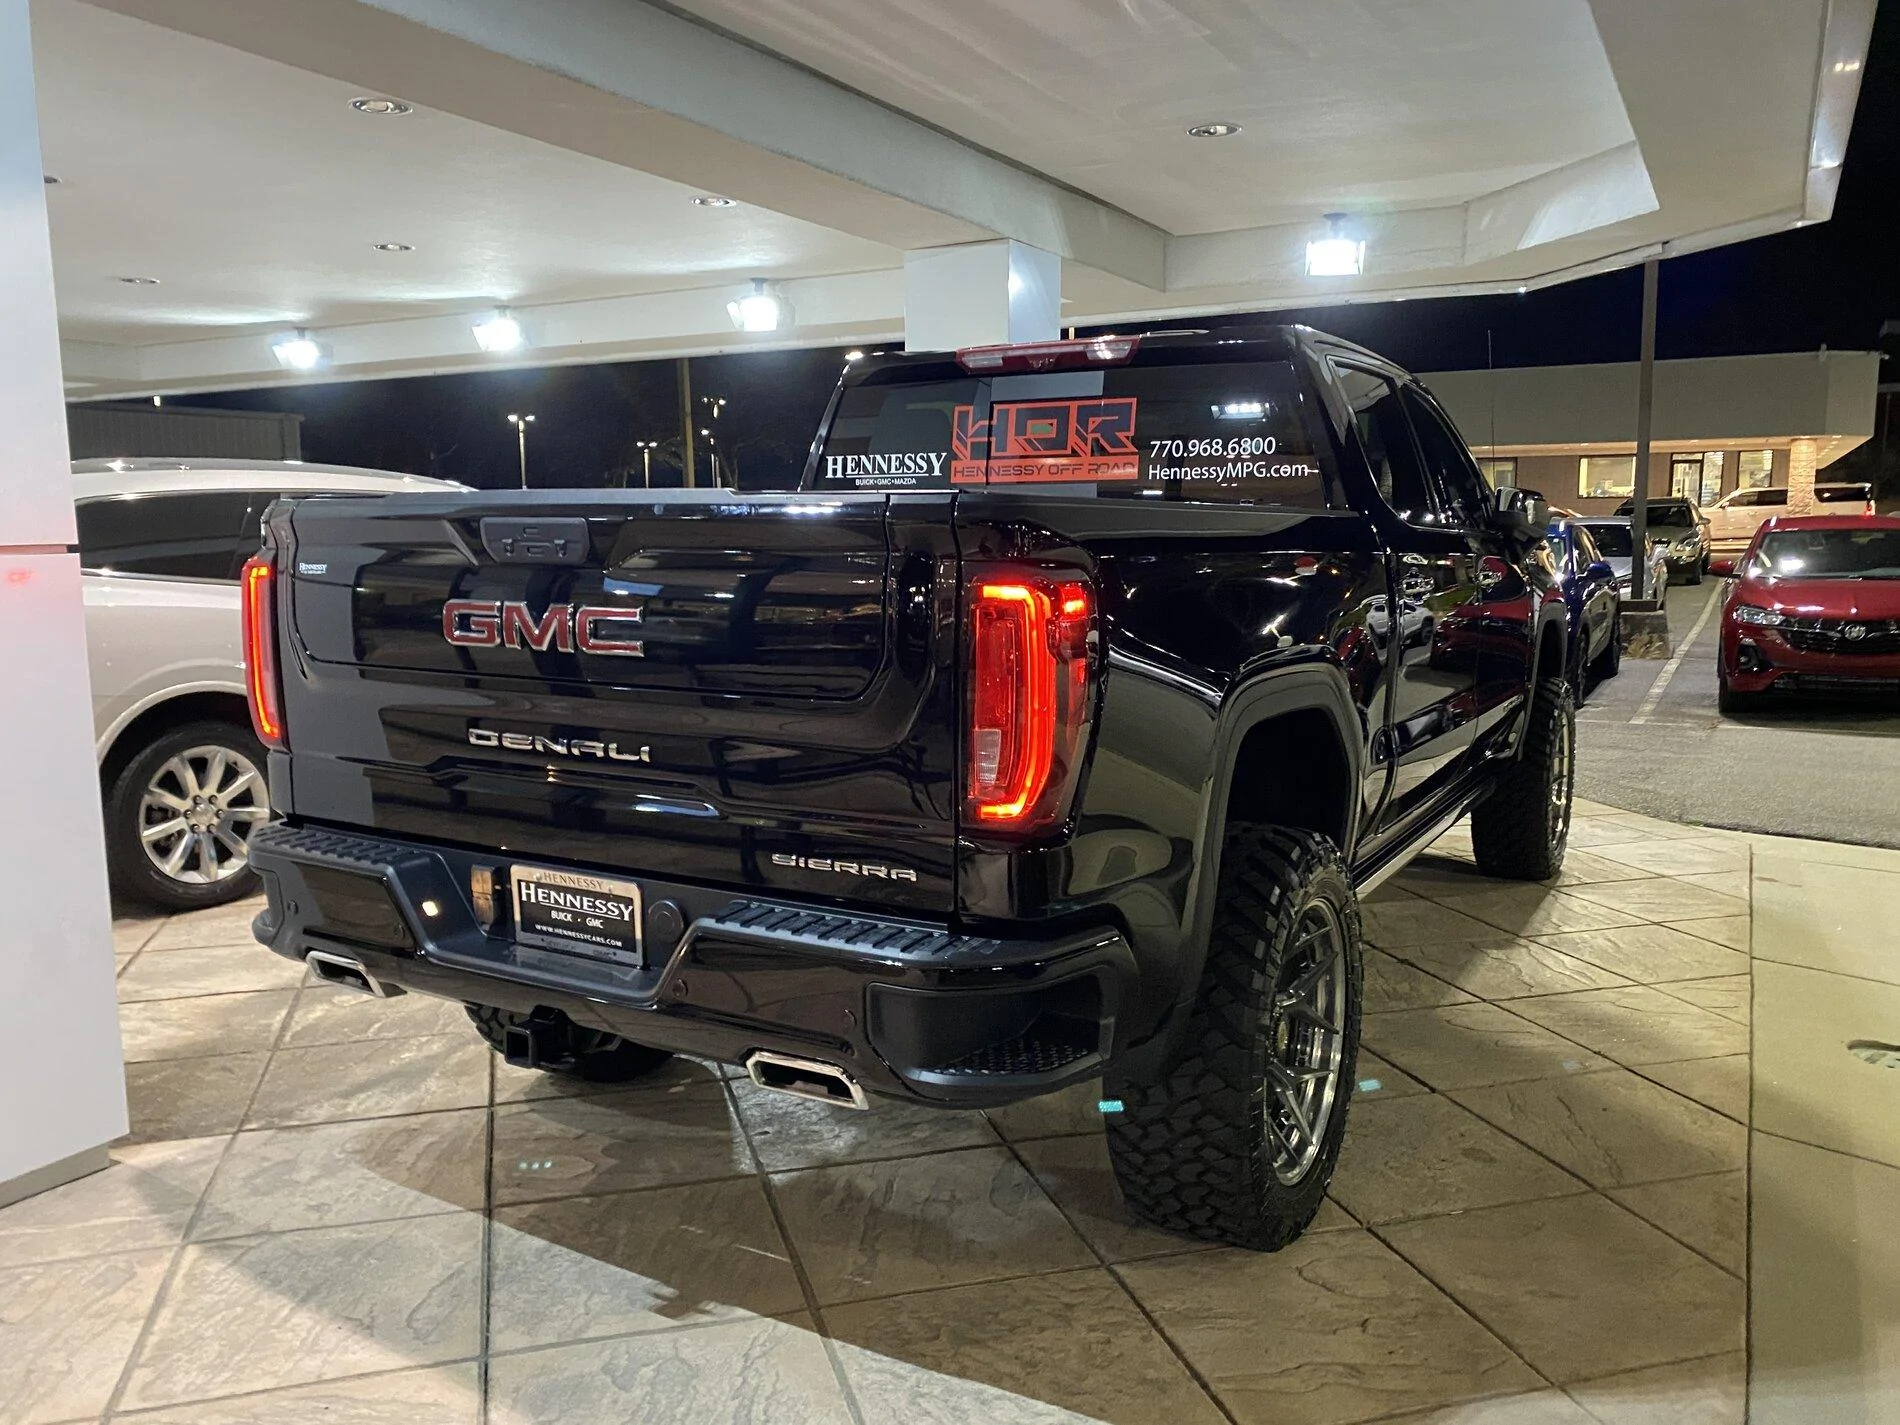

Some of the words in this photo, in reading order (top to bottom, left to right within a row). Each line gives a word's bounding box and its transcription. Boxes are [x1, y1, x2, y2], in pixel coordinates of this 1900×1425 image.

[1150, 436, 1276, 458] 770.968.6800
[825, 452, 947, 479] HENNESSY
[953, 464, 1046, 478] HENNESSY
[1048, 463, 1084, 476] OFF
[1087, 462, 1136, 475] ROAD
[1148, 461, 1308, 483] HennessyMPG.com
[442, 599, 645, 658] GMC
[468, 728, 651, 763] DENALI
[771, 853, 917, 882] SIERRA
[543, 872, 605, 888] HENNESSY
[520, 881, 634, 922] HENNESSY
[550, 910, 573, 923] BUICK
[585, 917, 604, 929] GMC
